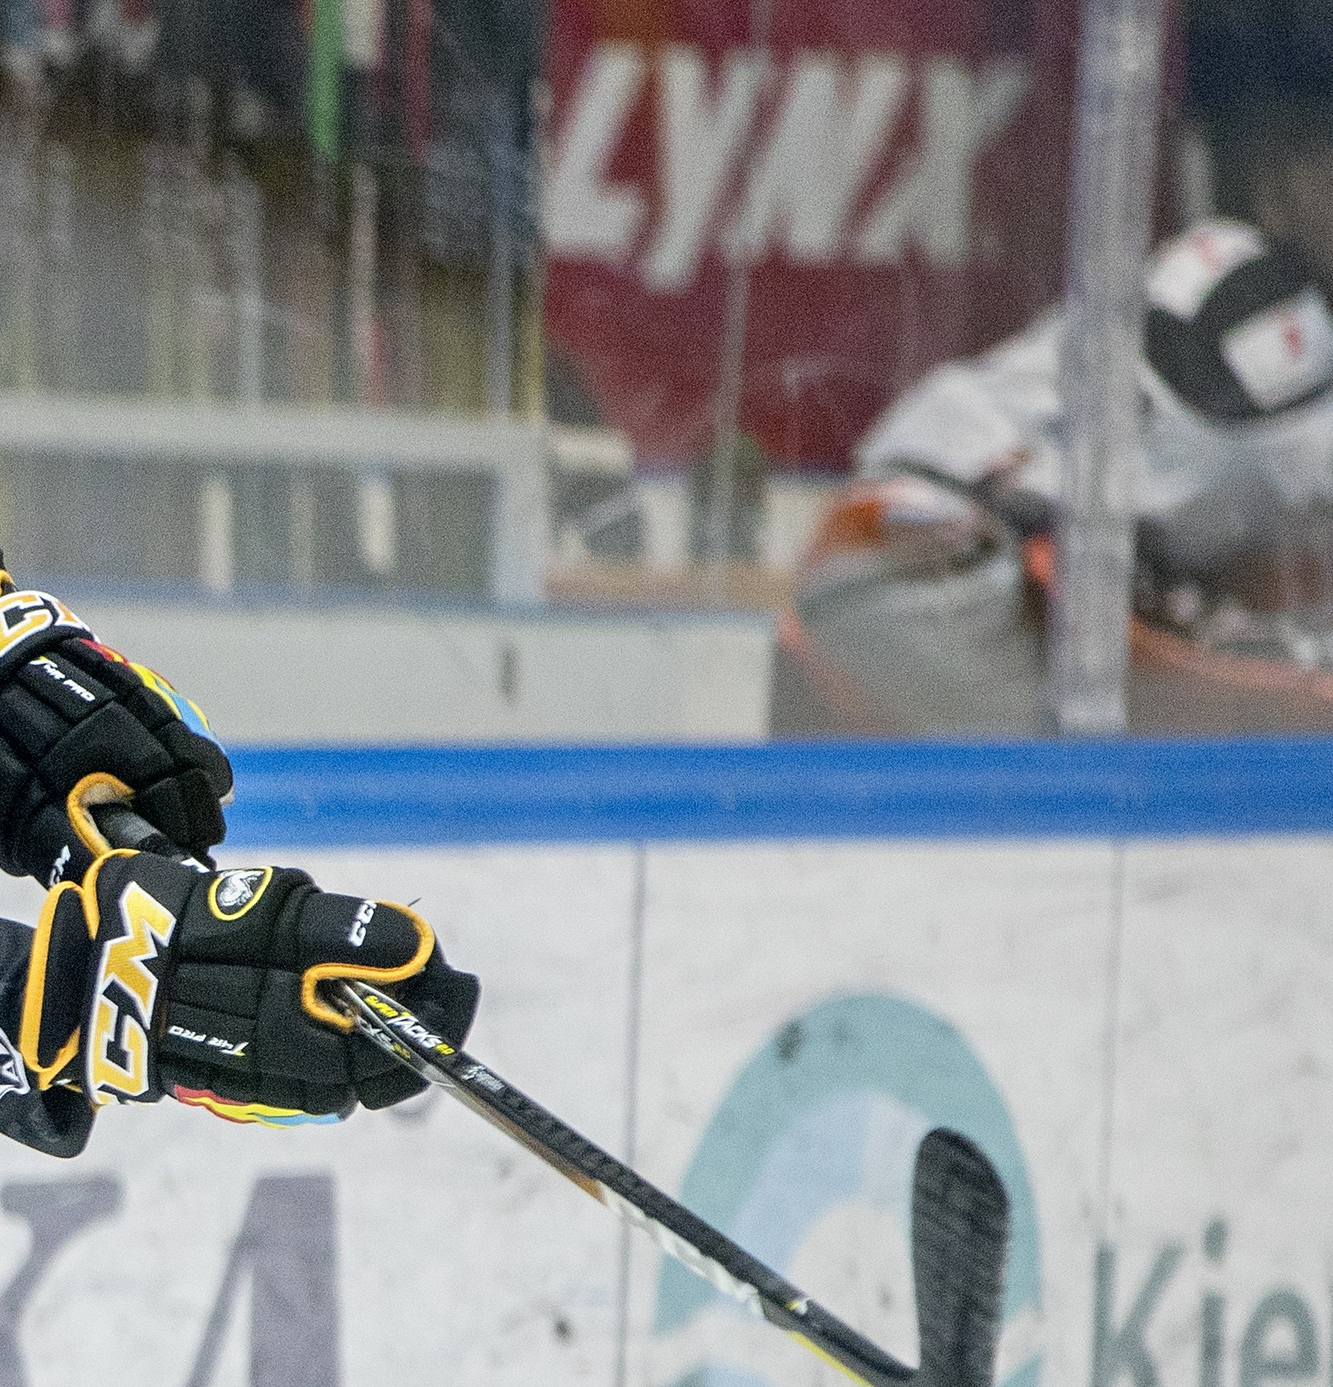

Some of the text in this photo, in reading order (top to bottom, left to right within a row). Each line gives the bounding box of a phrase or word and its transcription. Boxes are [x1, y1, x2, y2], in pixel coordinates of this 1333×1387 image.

[543, 42, 1032, 292] LYNX
[62, 678, 96, 702] PRO
[347, 899, 379, 948] CC
[168, 1025, 207, 1044] PRO
[386, 1011, 444, 1050] TACKS
